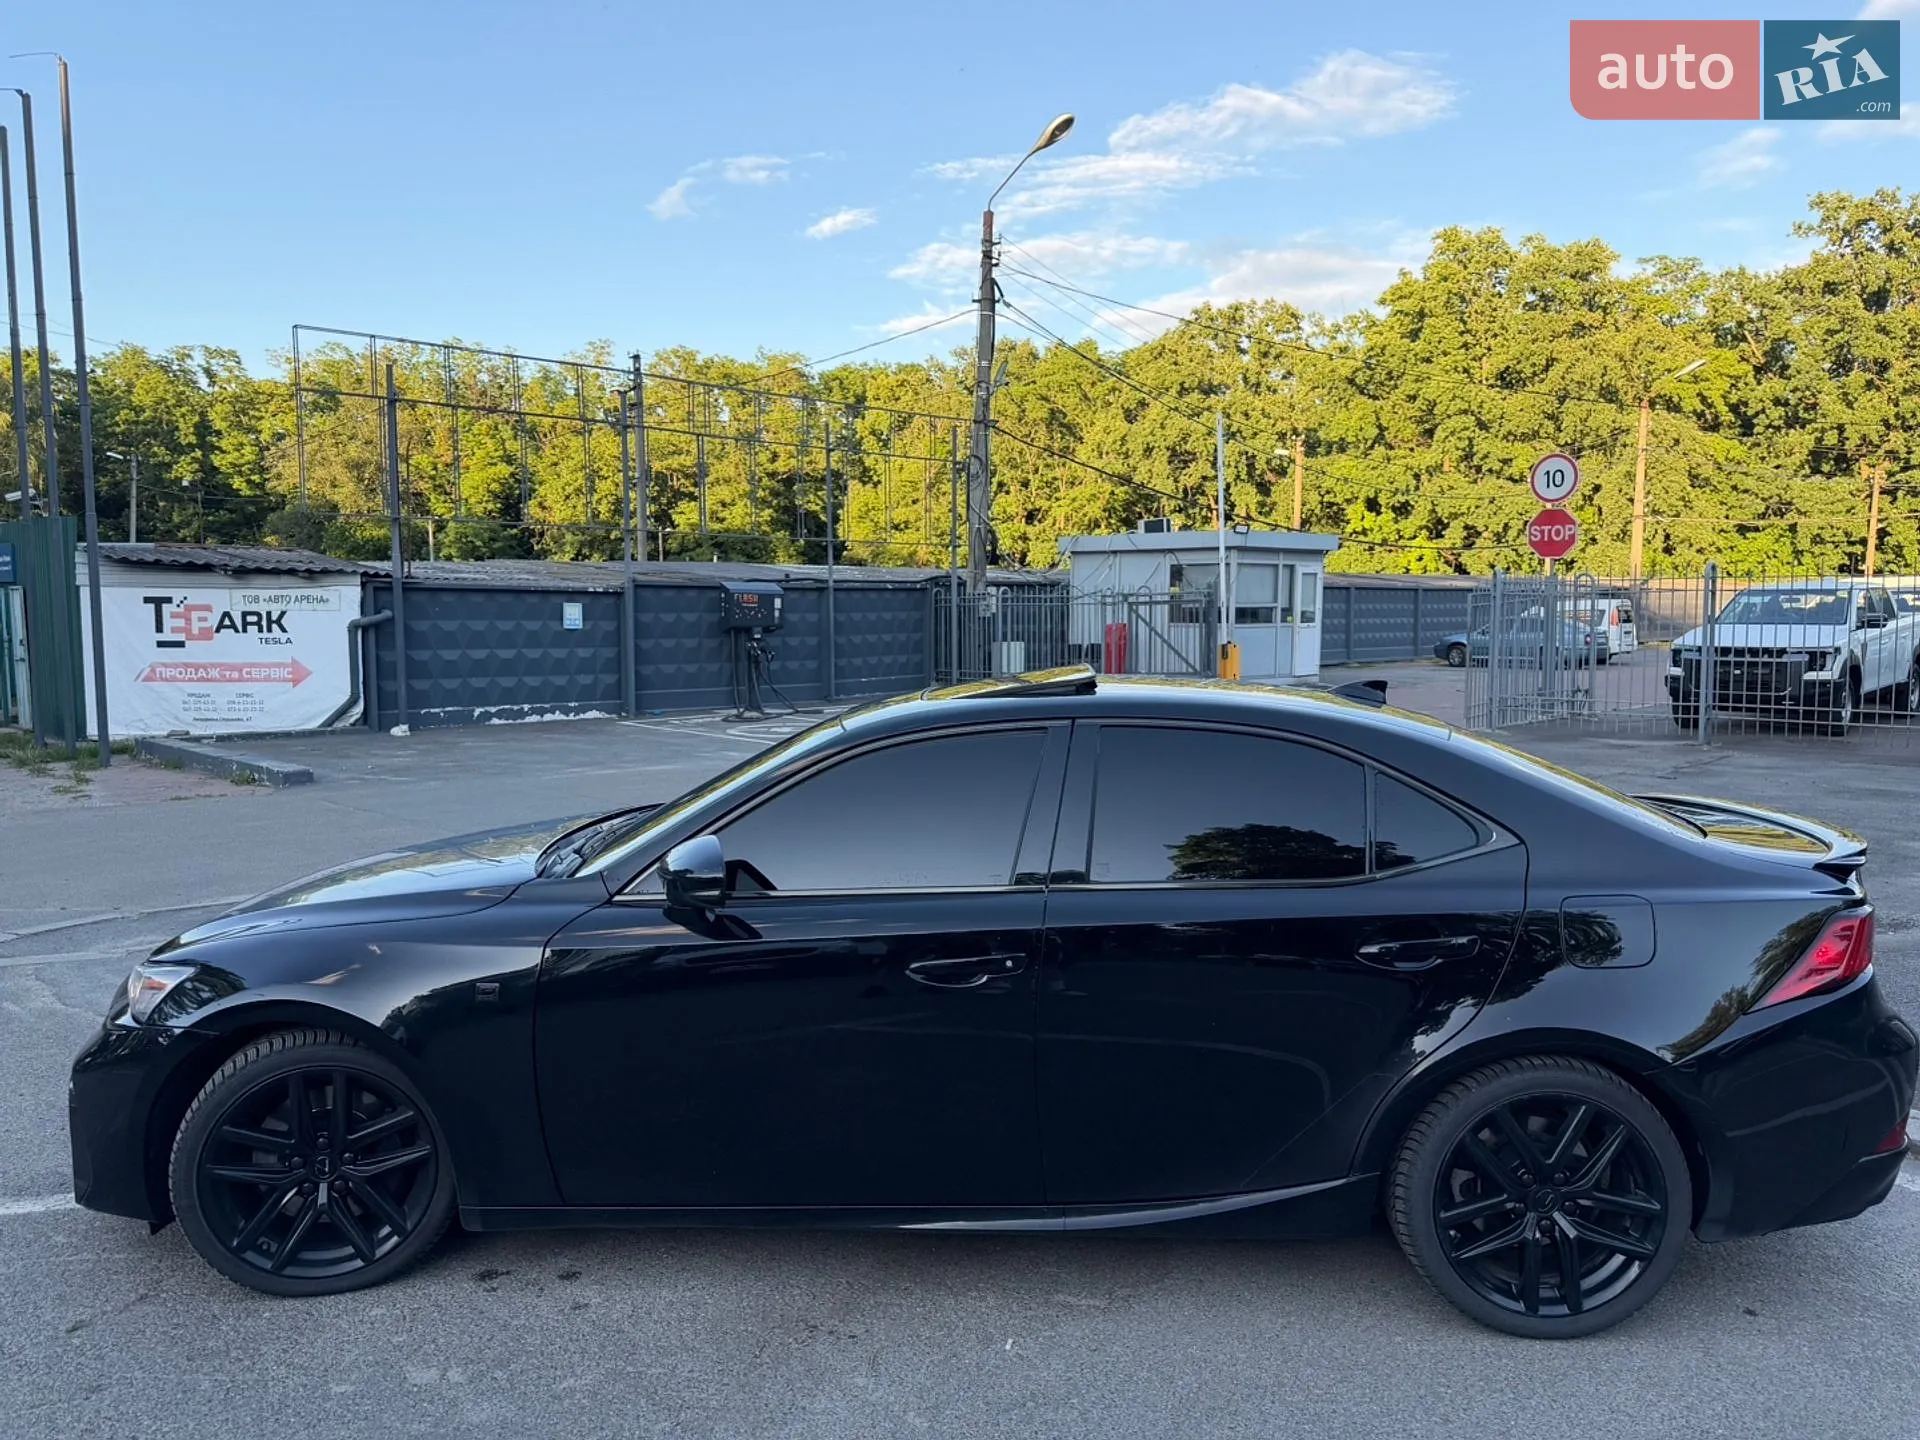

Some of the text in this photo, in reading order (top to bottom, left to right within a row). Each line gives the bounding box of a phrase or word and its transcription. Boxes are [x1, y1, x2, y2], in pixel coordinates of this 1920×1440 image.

[1543, 469, 1565, 488] 10
[1530, 525, 1576, 541] STOP
[242, 594, 260, 604] ТОВ
[258, 637, 293, 645] TESLA
[156, 668, 293, 680] ПРОДАЖ та СЕРВІС
